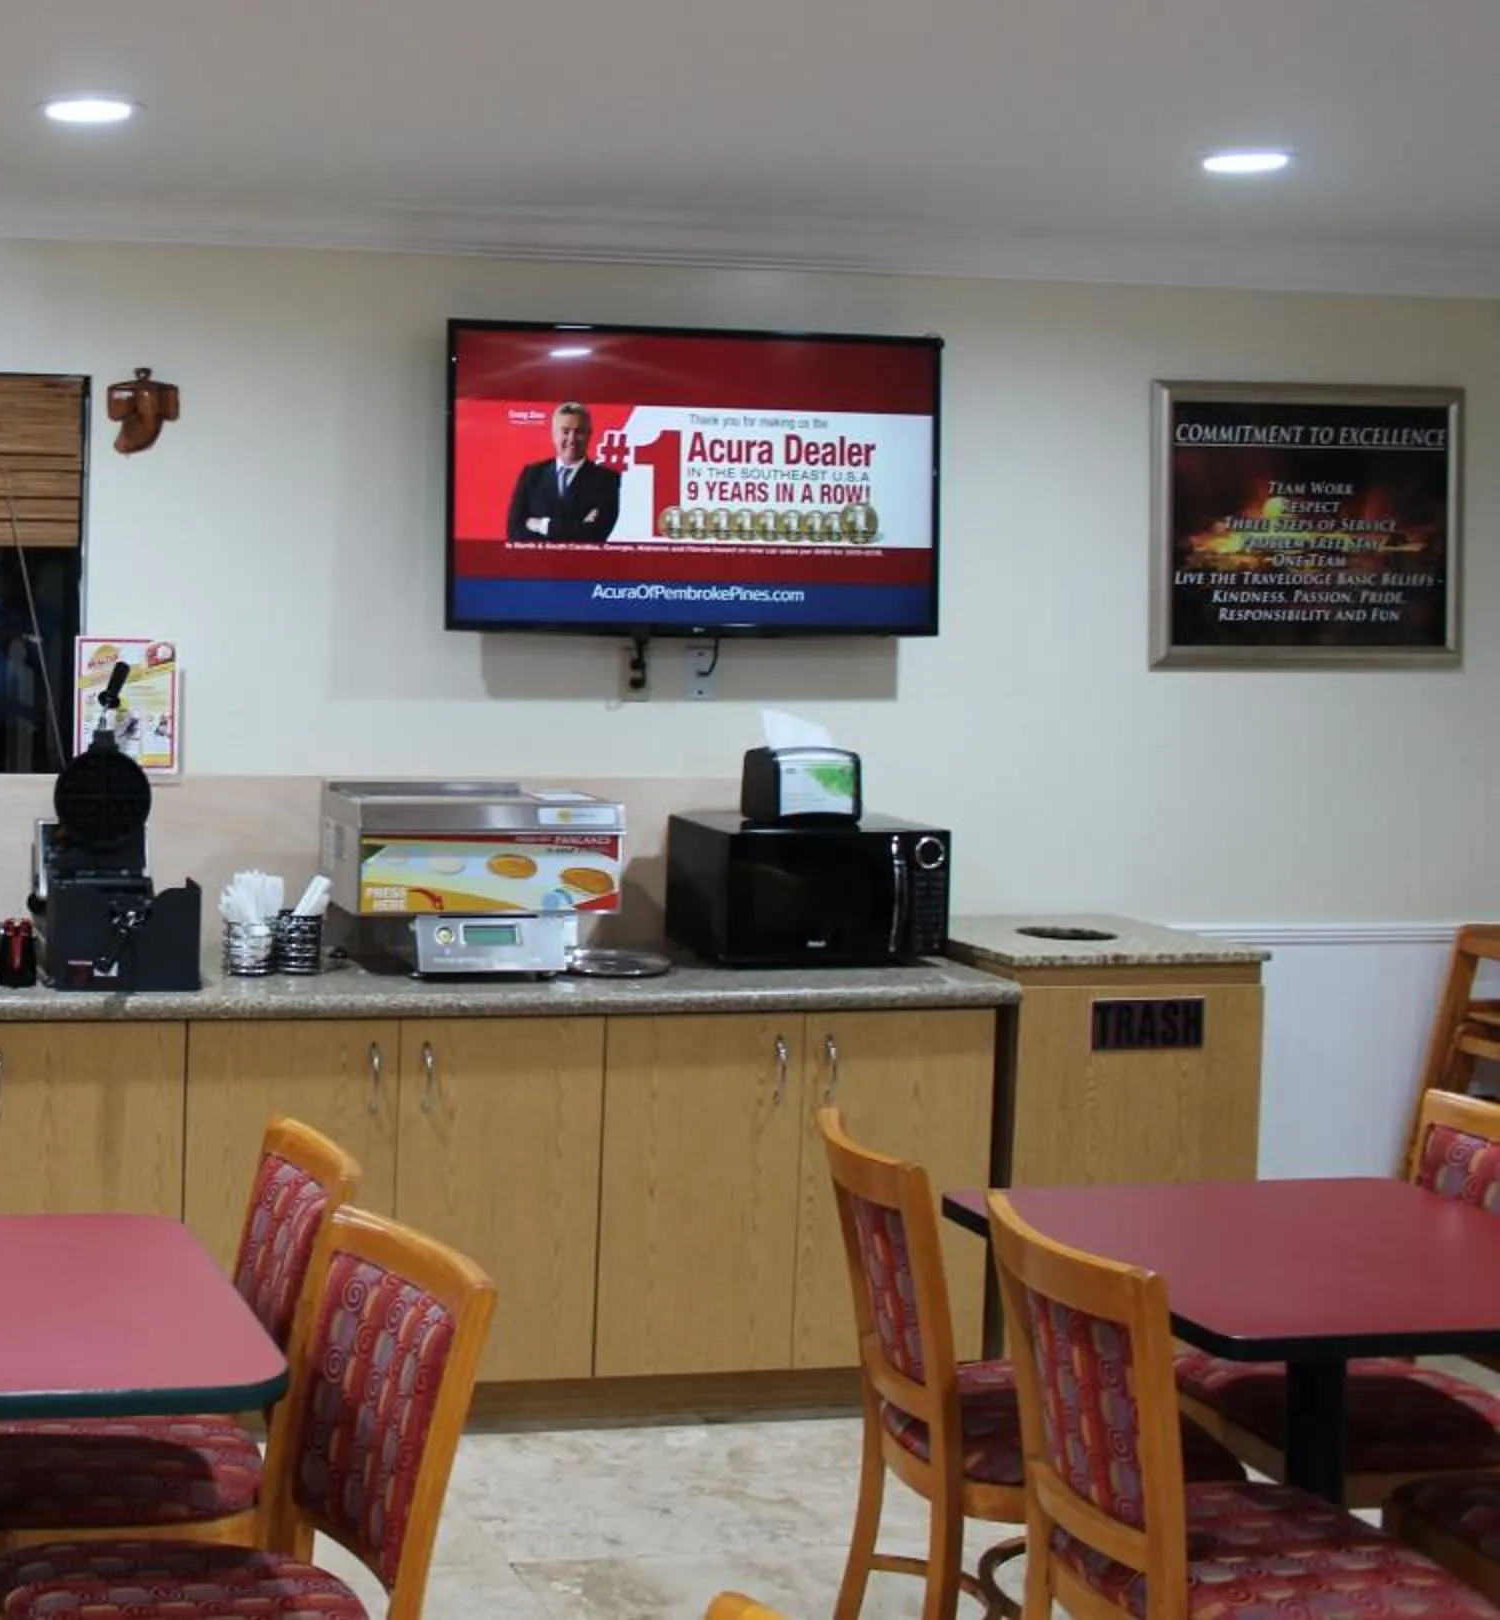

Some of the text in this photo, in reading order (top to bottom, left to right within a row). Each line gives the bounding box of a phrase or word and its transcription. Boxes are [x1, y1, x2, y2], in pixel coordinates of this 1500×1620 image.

[690, 414, 718, 425] Thank
[723, 415, 740, 428] you
[744, 416, 756, 427] for
[759, 416, 795, 430] making
[812, 418, 828, 428] the
[1175, 423, 1446, 446] COMMITMENT TO EXCELLENCE
[688, 432, 876, 468] Acura Dealer
[687, 467, 702, 478] IN
[707, 468, 735, 478] THE
[741, 468, 826, 481] SOUTHEAST
[687, 482, 871, 506] 9 YEARS IN A ROW!
[1175, 570, 1205, 585] LIVE
[1209, 572, 1237, 585] THE
[1243, 571, 1332, 585] TRAVELODGE
[592, 582, 805, 603] AcuraOfPembrokePines.com
[1218, 607, 1400, 621] RESPONSIBILITY AND FUN
[365, 887, 408, 899] PRESS
[1094, 1002, 1202, 1047] TRASH
